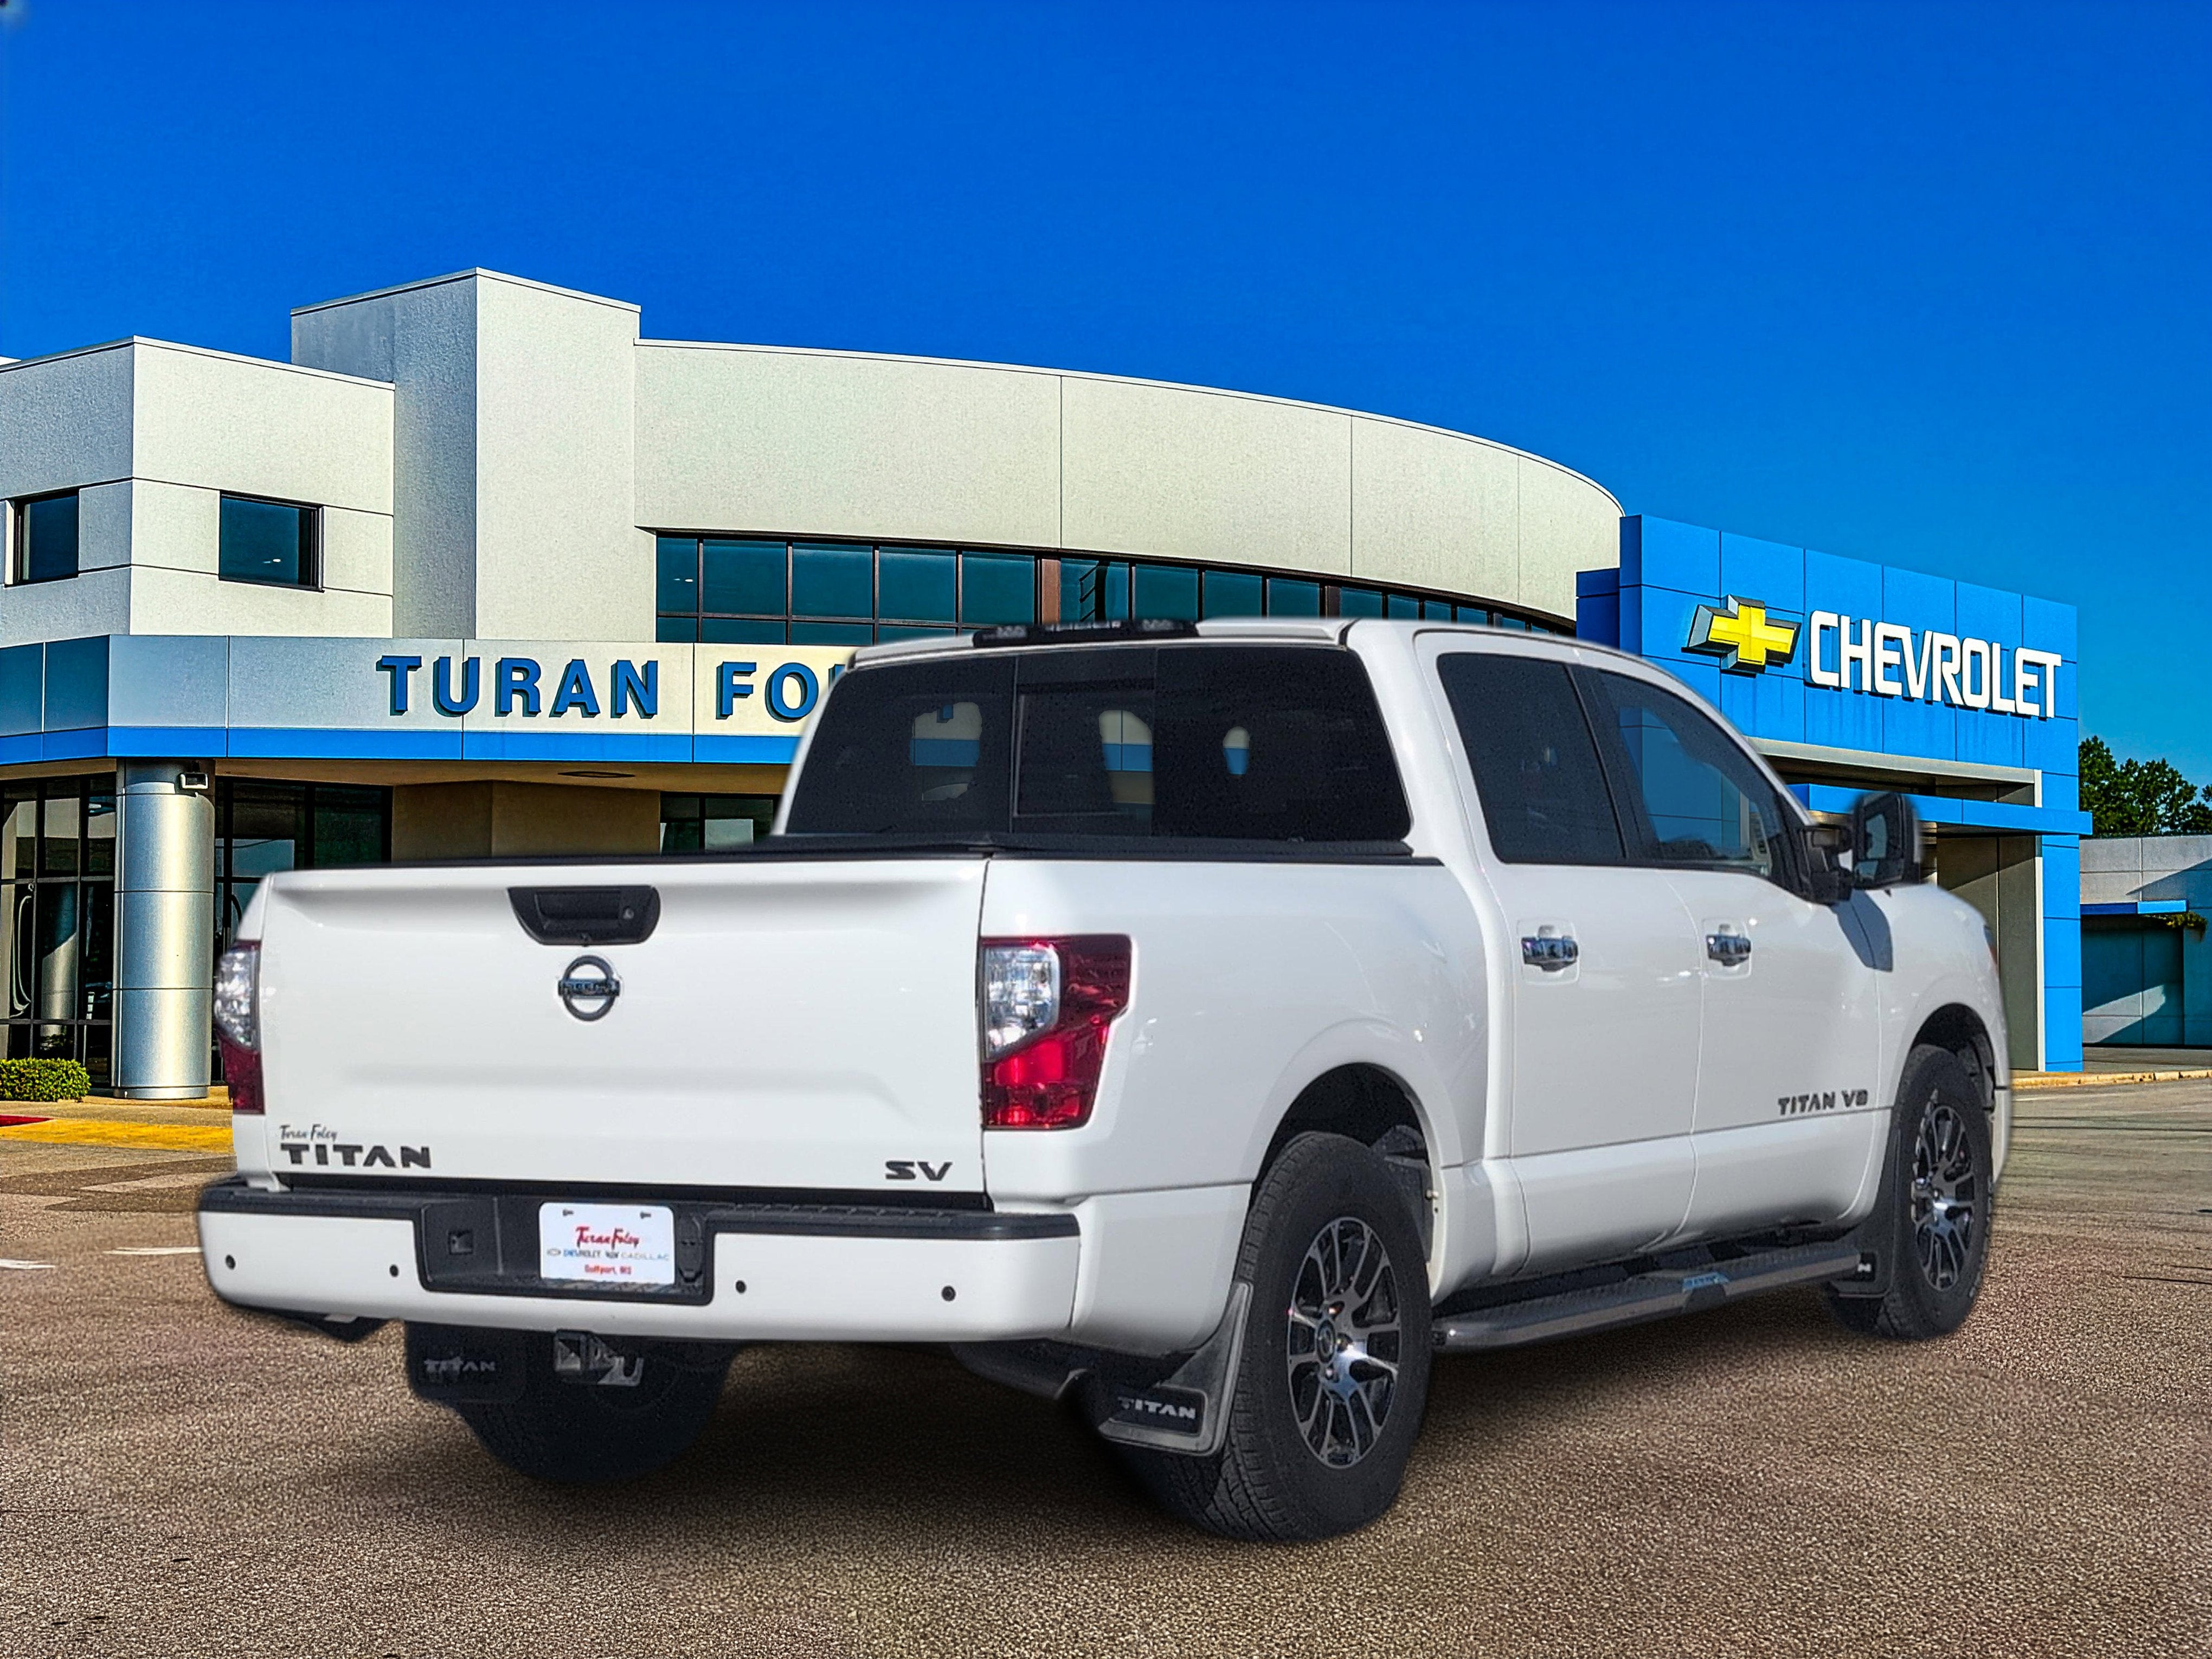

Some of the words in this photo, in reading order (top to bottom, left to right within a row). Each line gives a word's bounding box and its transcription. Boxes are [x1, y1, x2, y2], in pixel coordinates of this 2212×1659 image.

[1810, 610, 2061, 718] CHEVROLET
[376, 655, 658, 719] TURAN
[716, 661, 846, 723] FO
[1778, 1091, 1835, 1115] TITAN
[280, 1142, 432, 1168] TITAN
[885, 1161, 953, 1181] SV
[424, 1356, 496, 1374] TITAN
[1117, 1396, 1195, 1419] TITAN
